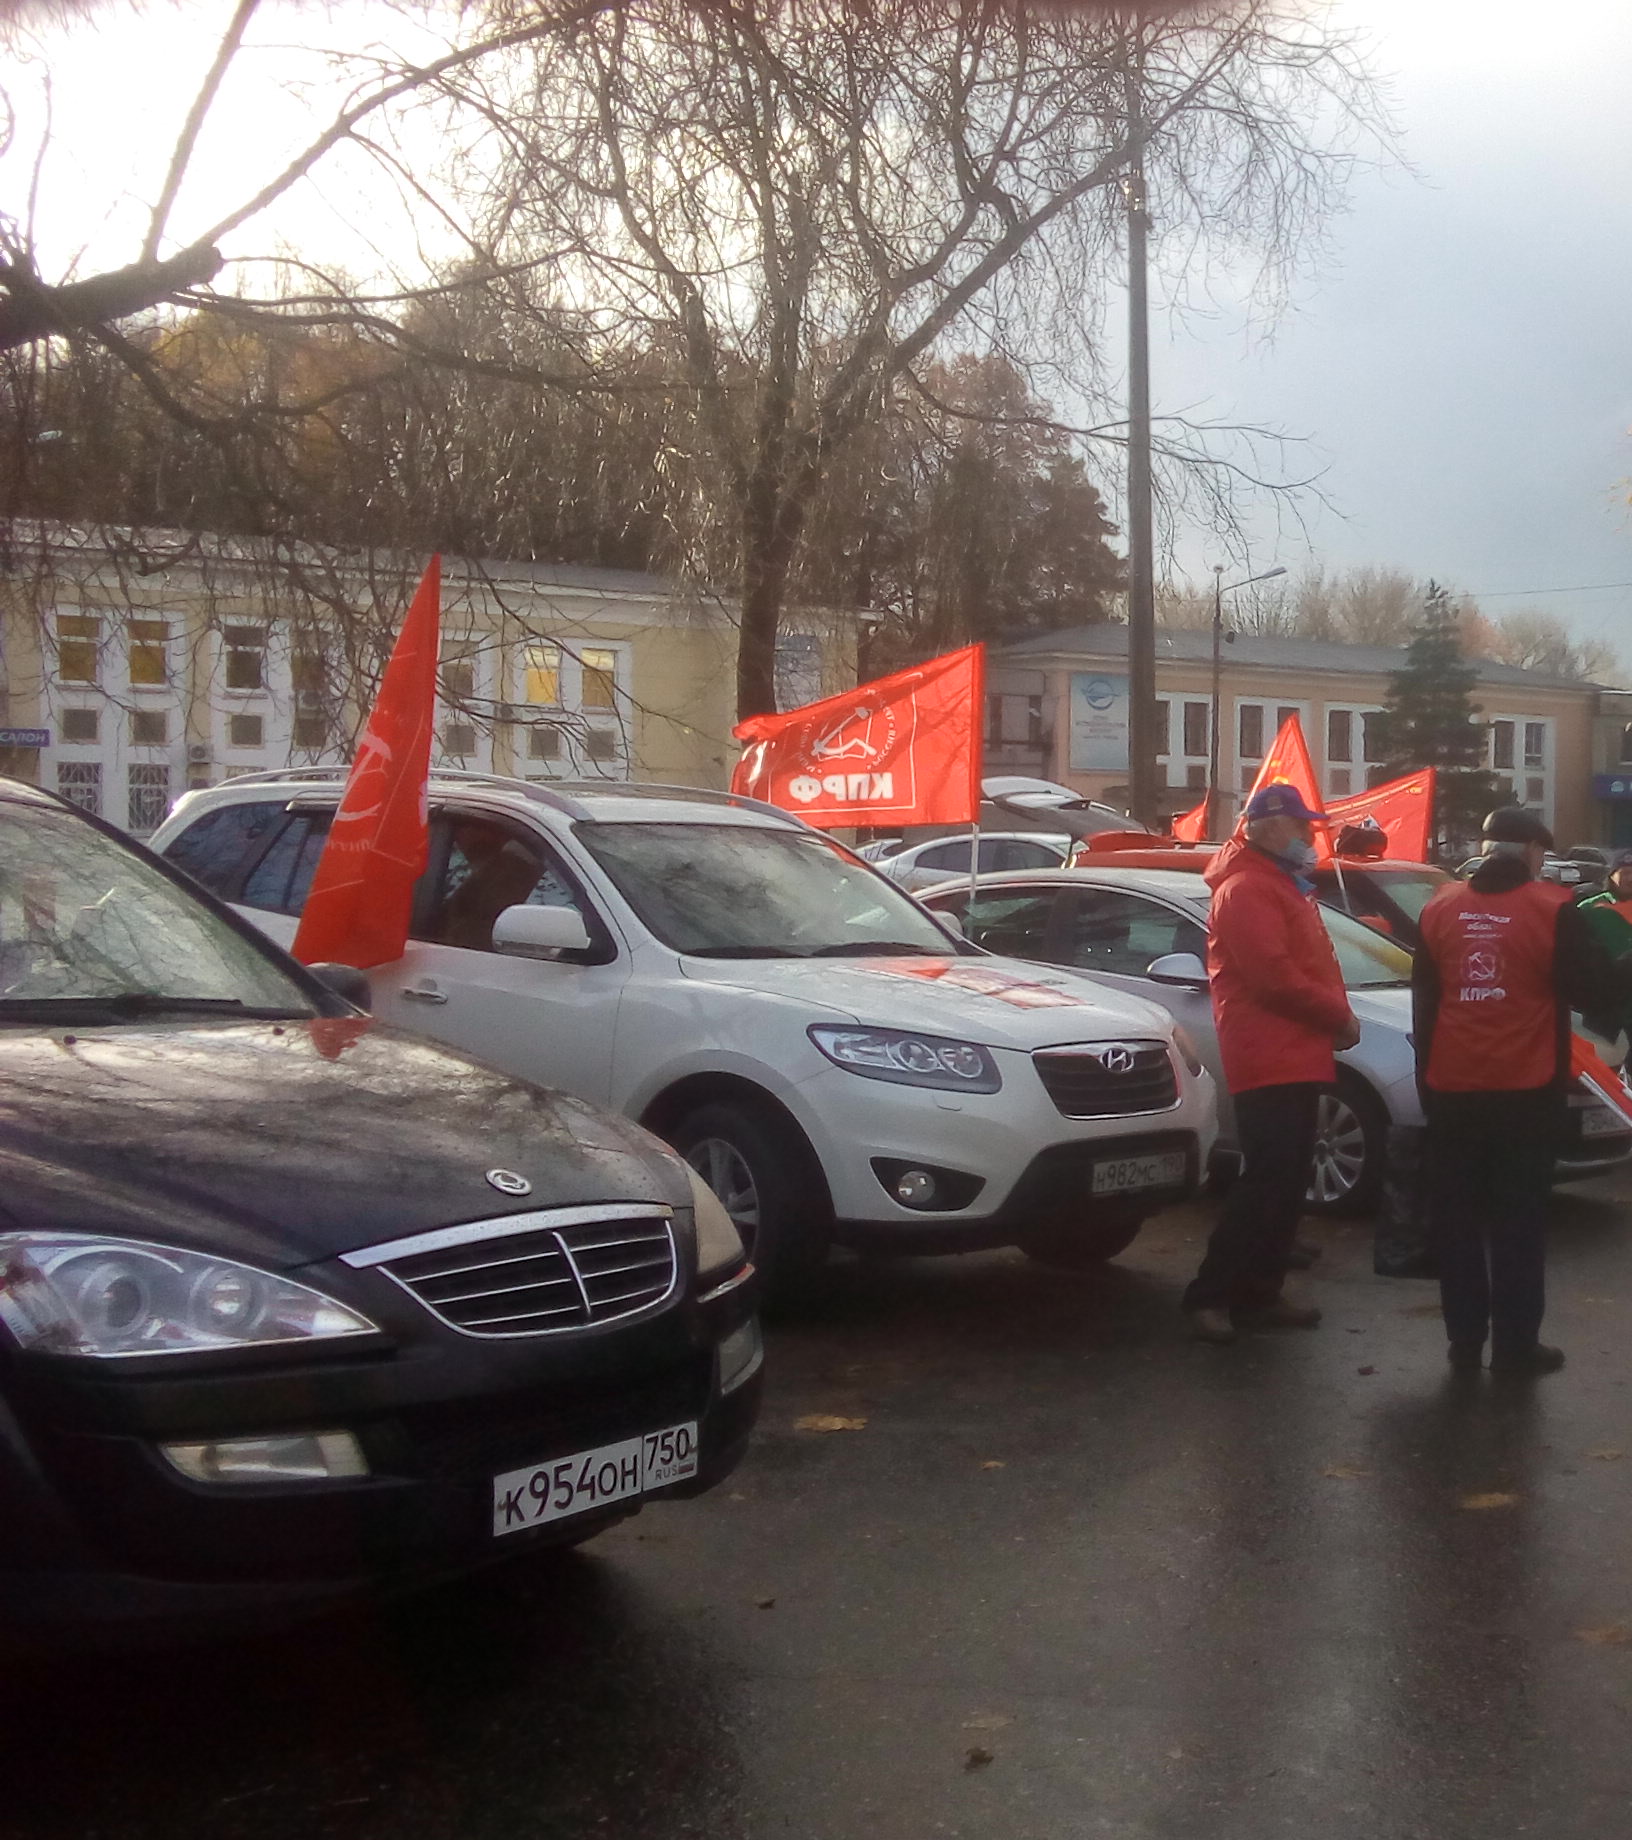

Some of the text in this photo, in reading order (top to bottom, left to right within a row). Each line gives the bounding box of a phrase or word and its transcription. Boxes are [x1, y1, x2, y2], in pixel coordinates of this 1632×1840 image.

[1460, 986, 1507, 1001] КПРФ
[645, 1428, 691, 1471] 750
[655, 1464, 678, 1481] RUS
